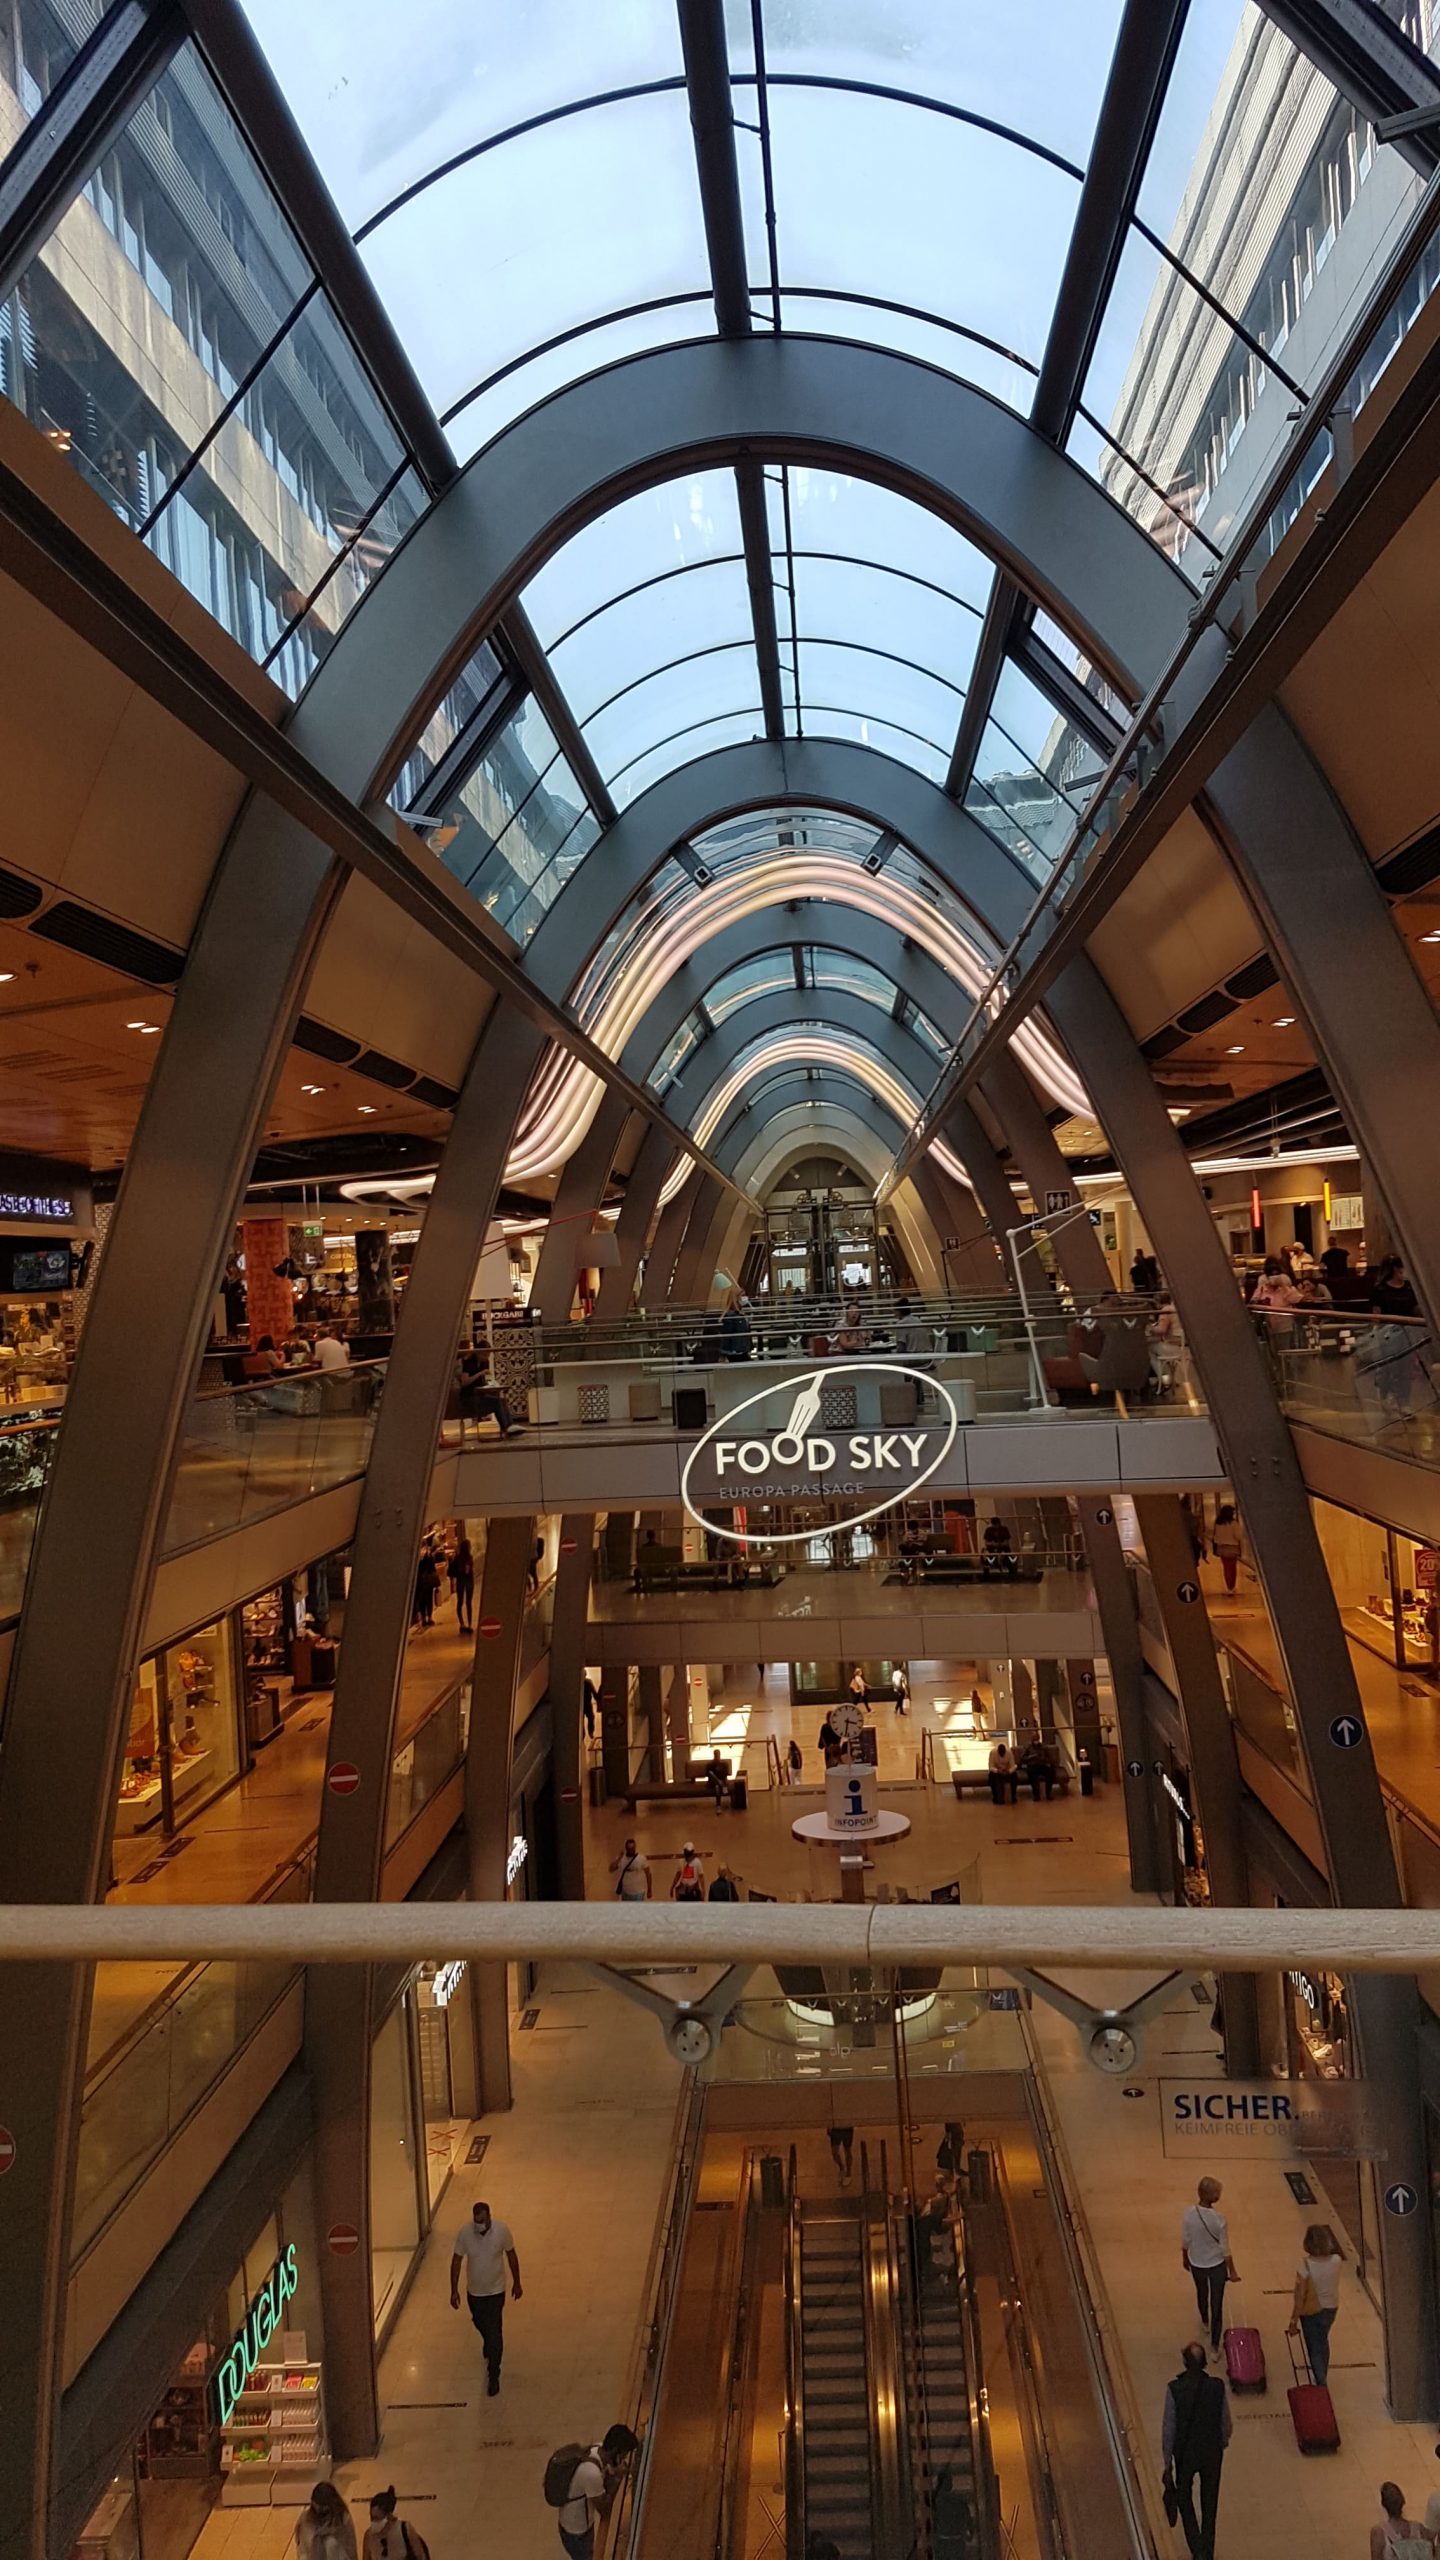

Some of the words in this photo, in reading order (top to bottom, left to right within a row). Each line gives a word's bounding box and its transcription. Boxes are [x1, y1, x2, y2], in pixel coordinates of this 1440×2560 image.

[716, 1431, 836, 1475] FOOD
[850, 1434, 928, 1470] SKY
[719, 1485, 786, 1499] EUROPA
[791, 1482, 865, 1497] PASSAGE
[834, 1816, 878, 1827] INFOPOINT
[1174, 2094, 1299, 2121] SICHER.
[1175, 2121, 1258, 2137] KEIMFREIE
[218, 2242, 299, 2426] DOUGLAS
